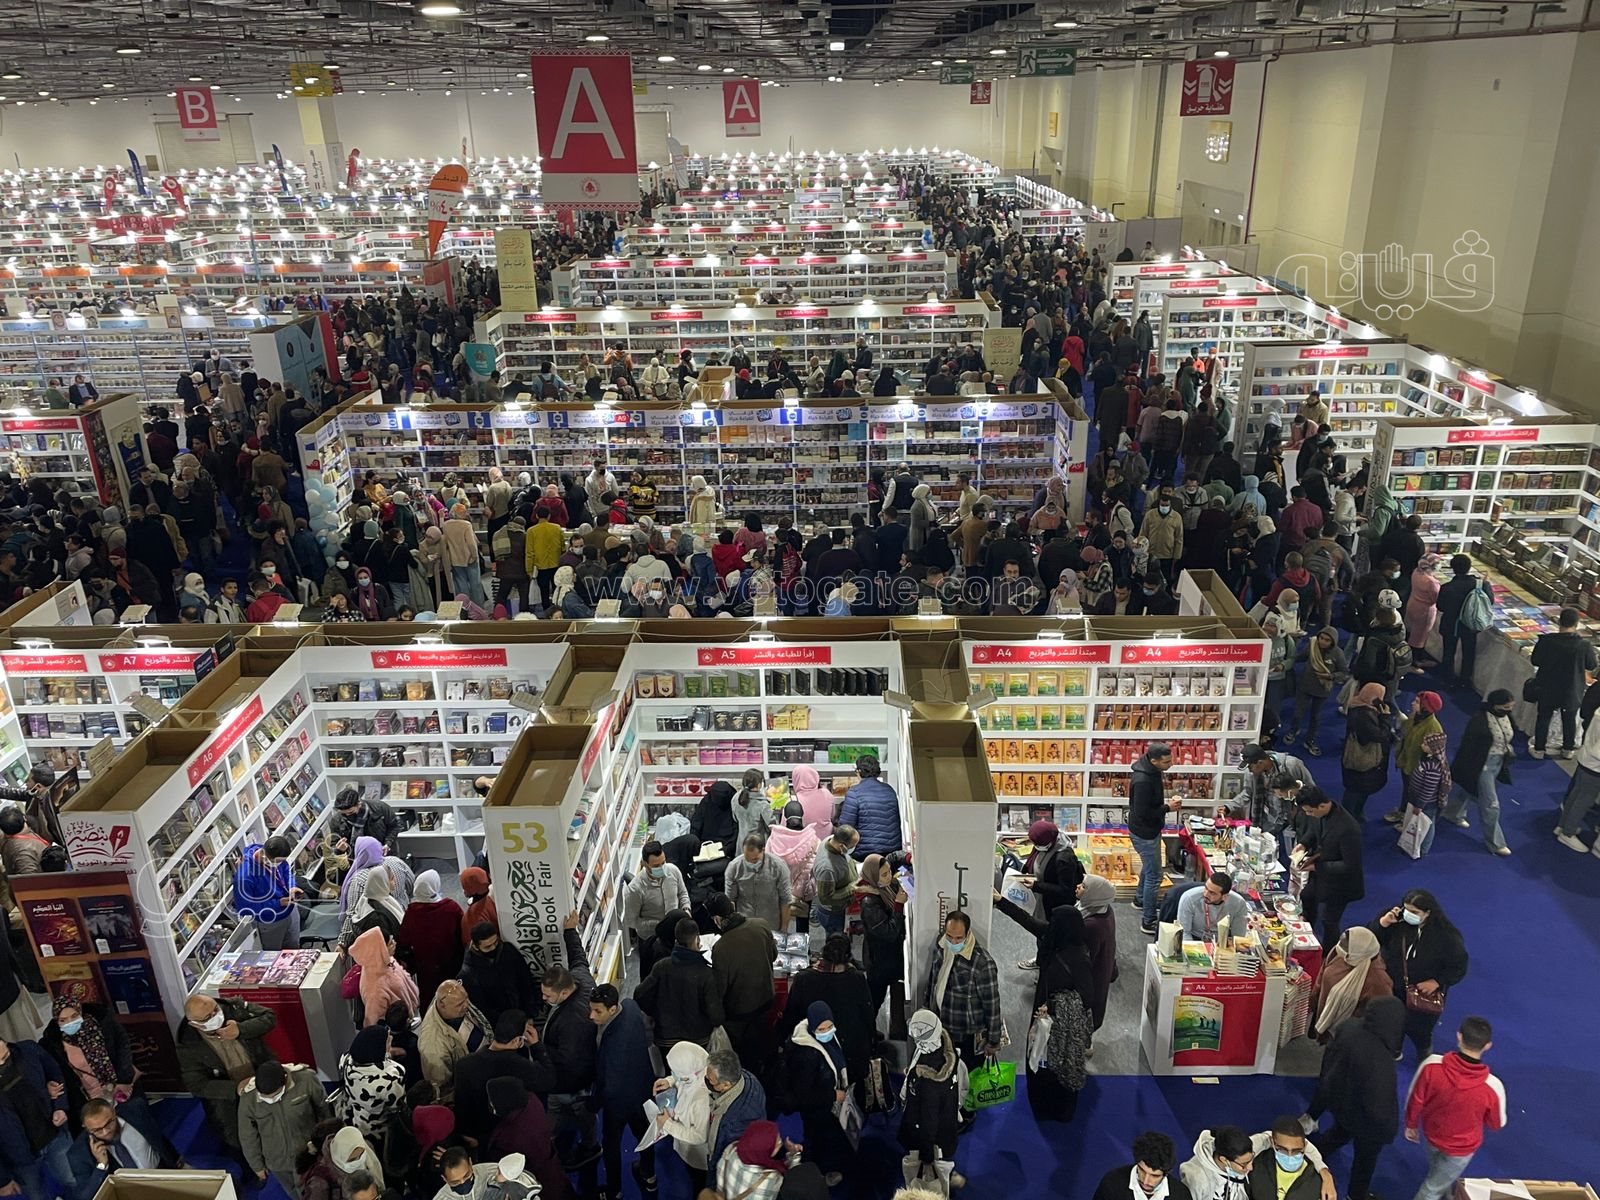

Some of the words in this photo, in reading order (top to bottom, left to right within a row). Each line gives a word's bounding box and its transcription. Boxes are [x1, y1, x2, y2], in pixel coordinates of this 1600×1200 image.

[729, 85, 757, 118] A
[185, 91, 210, 124] B
[1186, 104, 1204, 113] حريق
[1206, 103, 1225, 112] طفاية
[550, 67, 625, 160] A
[721, 650, 736, 659] A5
[753, 649, 775, 659] والنشر
[776, 648, 801, 658] للطباعة
[997, 648, 1012, 657] A4
[1028, 648, 1056, 659] والتوزيع
[1057, 648, 1077, 657] للنشر
[1079, 646, 1097, 656] مبتدأ
[1145, 647, 1161, 657] A4
[1178, 647, 1206, 658] والتوزيع
[1208, 647, 1228, 656] للنشر
[1230, 645, 1248, 655] مبتدأ
[26, 657, 44, 665] للنشر
[123, 656, 137, 665] A7
[144, 656, 170, 665] والتوزيع
[171, 656, 190, 664] للنشر
[395, 652, 410, 662] A6
[440, 653, 458, 661] والتوزيع
[202, 749, 213, 765] A6
[501, 821, 548, 854] 53
[536, 861, 553, 887] Fair
[541, 896, 559, 934] Book
